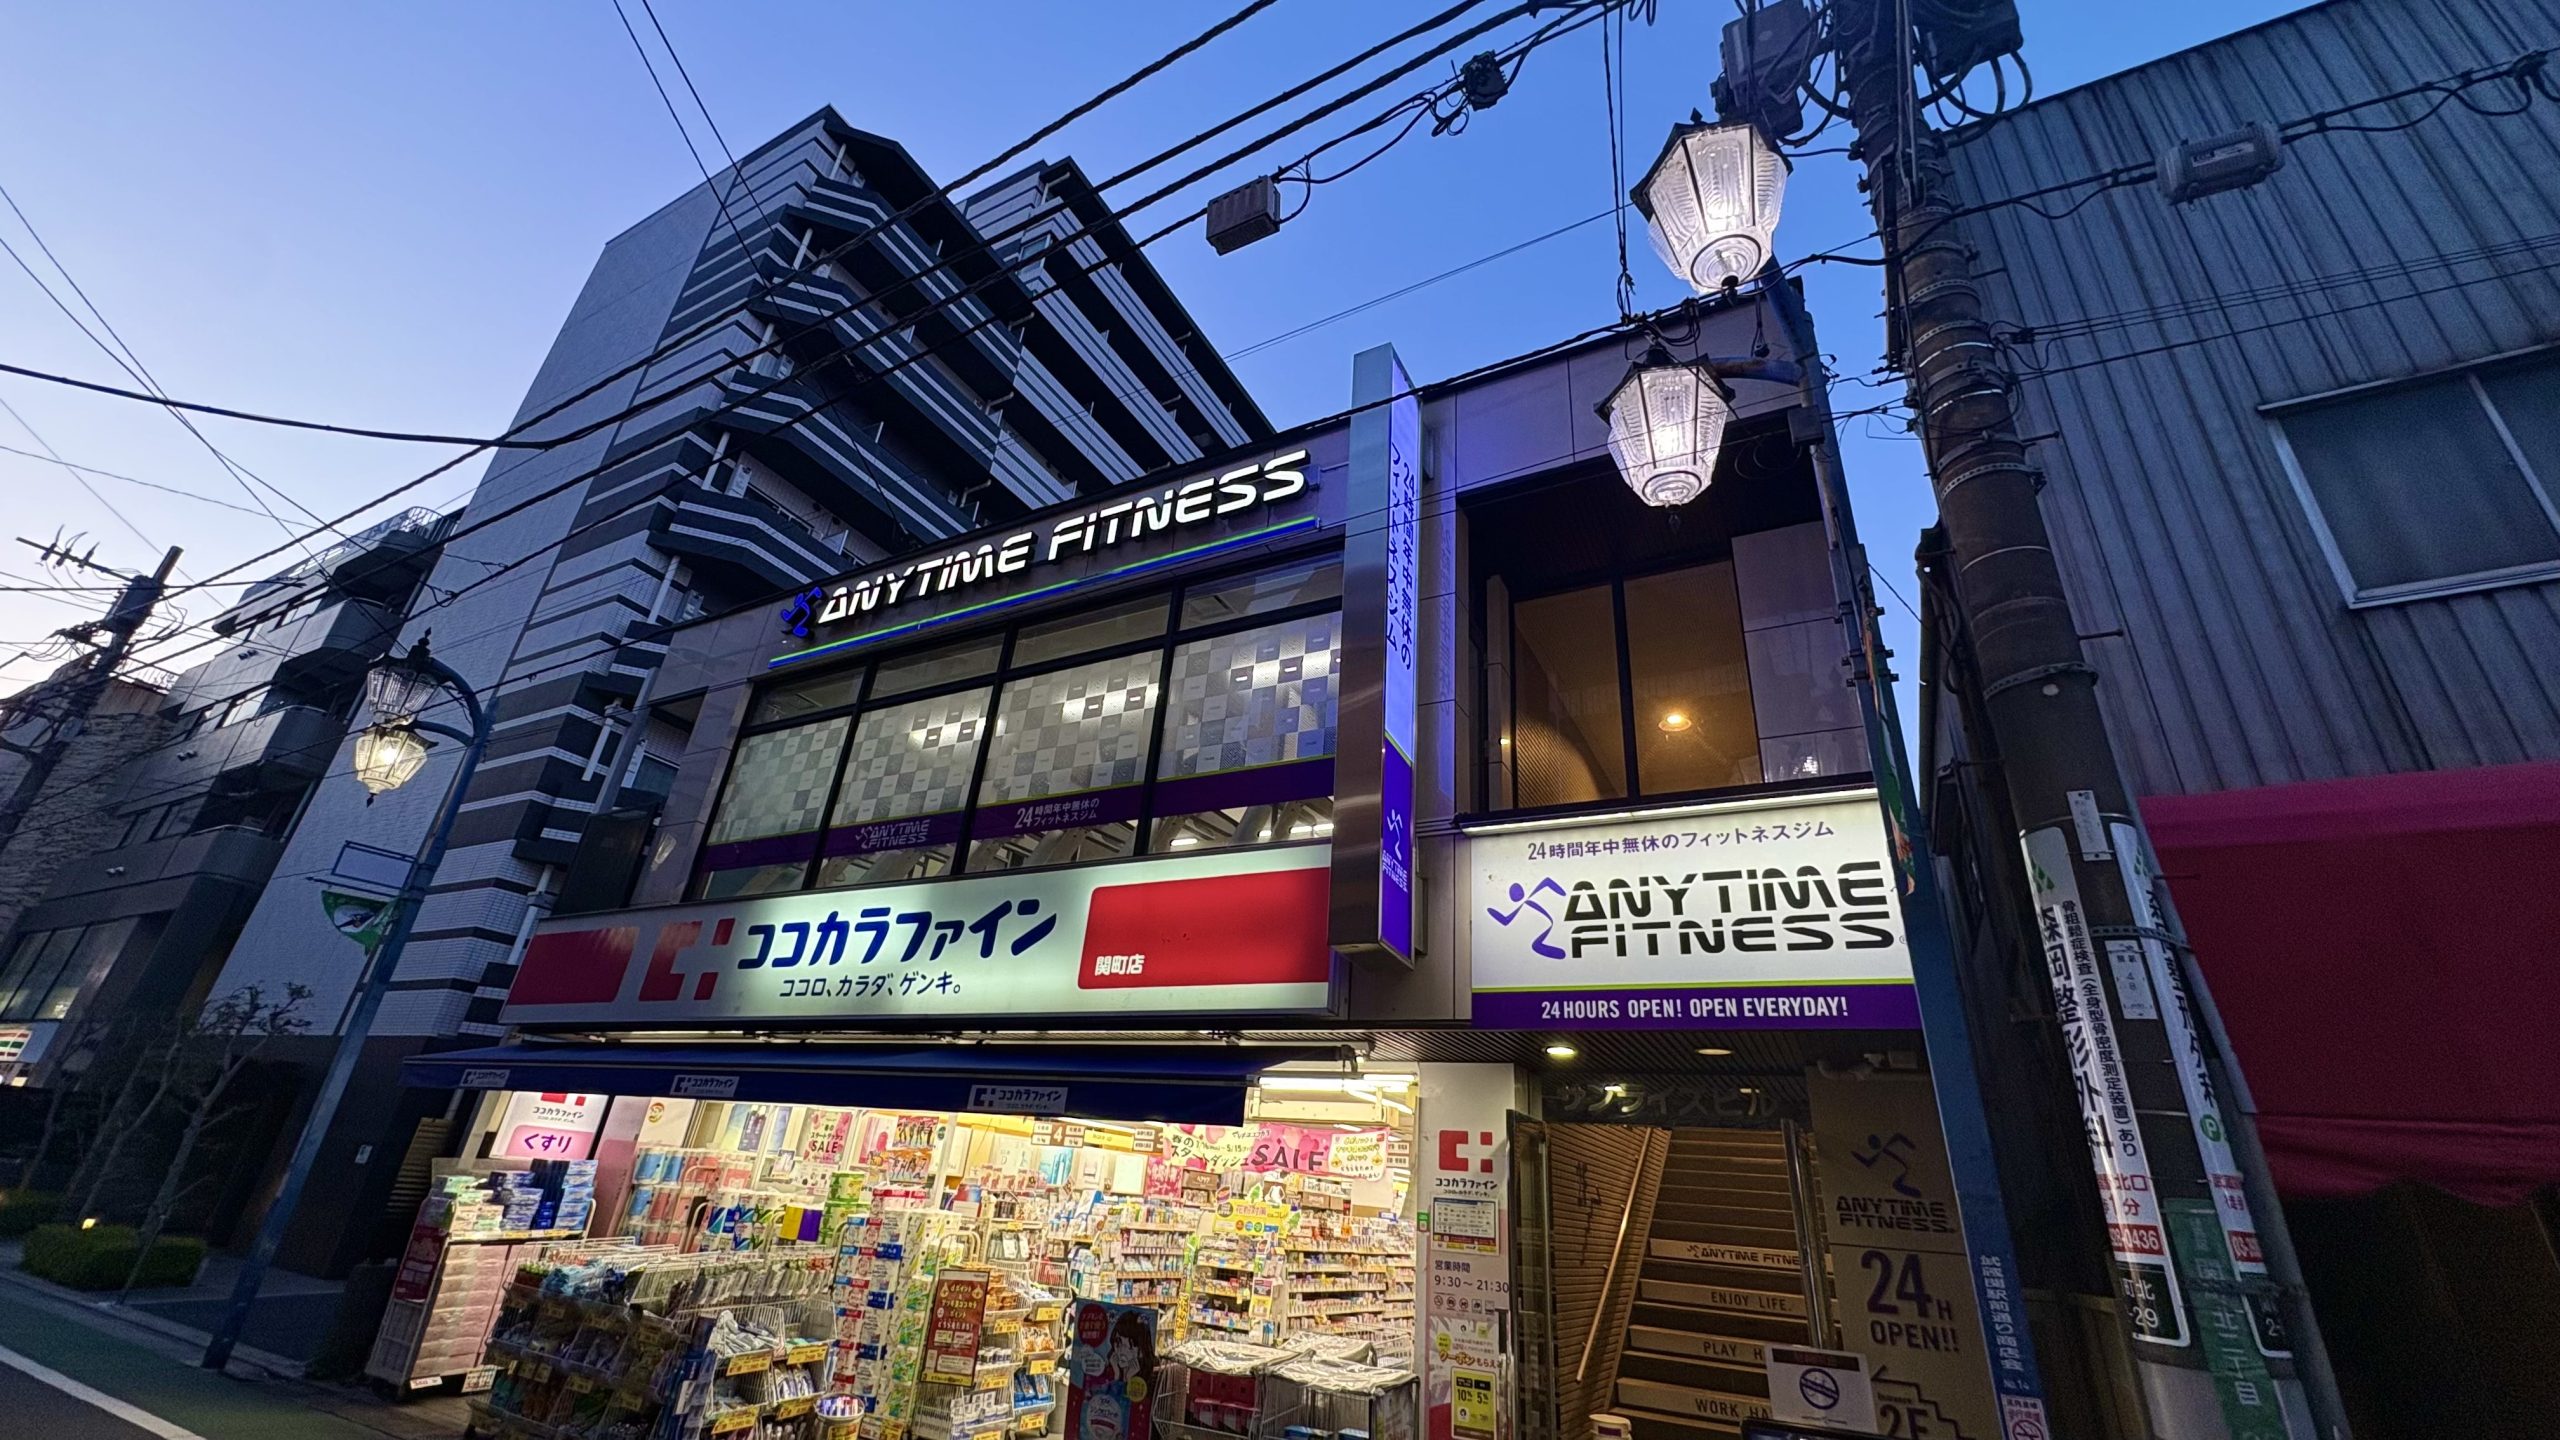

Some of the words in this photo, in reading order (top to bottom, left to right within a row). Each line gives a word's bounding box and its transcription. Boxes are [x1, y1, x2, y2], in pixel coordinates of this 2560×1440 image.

[817, 531, 1036, 624] ANYTIME
[1048, 450, 1307, 561] FITNESS
[1014, 807, 1034, 828] 24
[1034, 798, 1100, 816] 時間年中無休の
[869, 819, 931, 839] ANYTIME
[1033, 810, 1098, 827] フィットネスジム
[868, 832, 928, 849] FITNESS
[1528, 821, 1835, 861] 24時間年中無休のフィットネスジム
[1563, 861, 1888, 921] ANYTIME
[738, 898, 1057, 970] ココカラファイン
[1571, 911, 1895, 959] FITNESS
[1094, 954, 1146, 976] 関町店
[780, 972, 961, 998] ココロ、カラダ、ゲンキ。
[1628, 998, 1682, 1018] OPEN!
[1690, 998, 1738, 1017] OPEN
[1743, 996, 1849, 1017] EVERYDAY!
[690, 1078, 734, 1089] ココカラファイン
[998, 1087, 1062, 1102] ココカラファイン
[1558, 1081, 1778, 1118] サンライズビル
[532, 1106, 585, 1119] ココカラファイン
[524, 1133, 573, 1154] くすり
[810, 1140, 838, 1154] SALE
[1172, 1134, 1195, 1148] 春の
[1171, 1145, 1249, 1167] スタートダッシュ
[1435, 1177, 1498, 1190] ココカラファイン
[1836, 1195, 1948, 1219] ANYTIME
[1839, 1213, 1951, 1234] FITNESS
[1701, 1246, 1759, 1262] ANYTIME
[1434, 1260, 1471, 1273] 営業時間
[1711, 1291, 1750, 1307] ENJOY
[1759, 1296, 1793, 1312] LIFE.
[1980, 1254, 2025, 1373] 武蔵関駅前通り商店会
[1870, 1320, 1959, 1352] OPEN!!
[1703, 1341, 1737, 1358] PLAY
[1696, 1398, 1740, 1418] WORK
